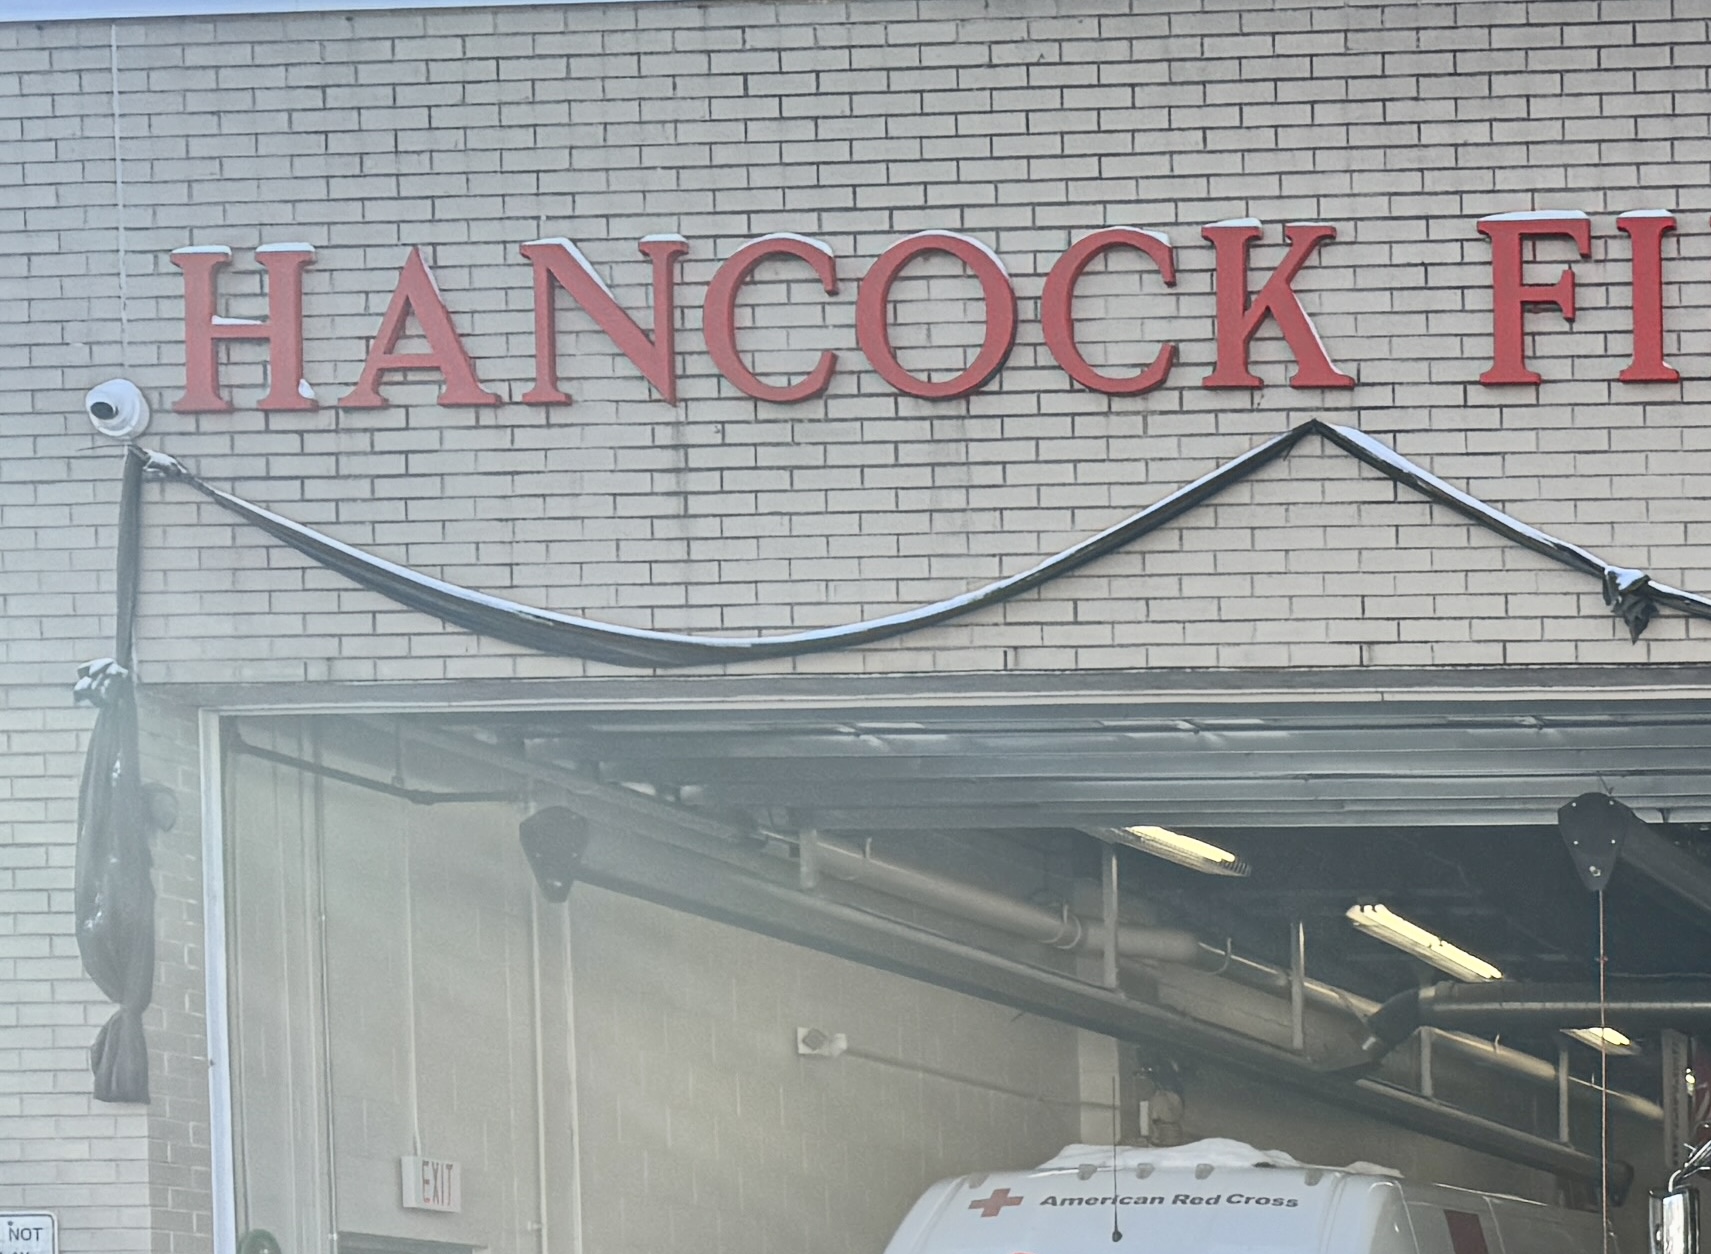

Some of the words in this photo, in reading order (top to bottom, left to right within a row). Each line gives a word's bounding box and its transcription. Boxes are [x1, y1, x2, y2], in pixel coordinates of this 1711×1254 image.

[168, 220, 1356, 414] HANCOCK
[422, 1159, 453, 1206] EXIT
[1040, 1194, 1164, 1207] American
[1171, 1193, 1222, 1206] Red
[1226, 1193, 1299, 1208] Cross
[9, 1227, 43, 1241] NOT
